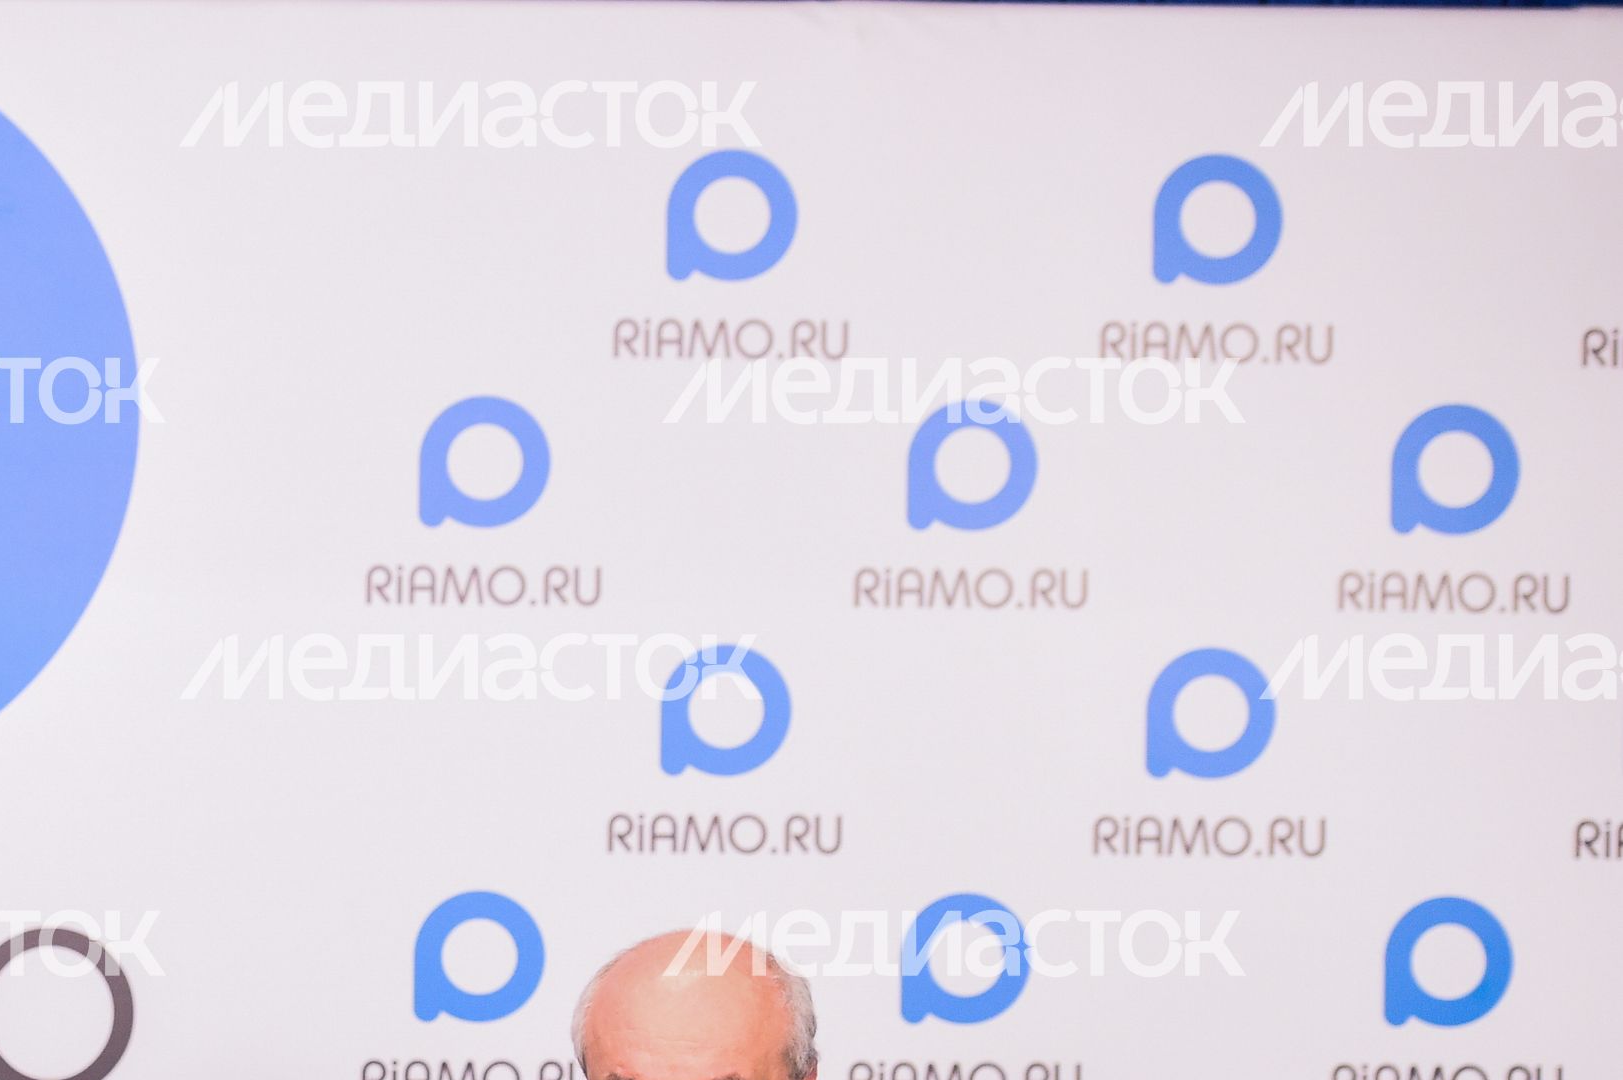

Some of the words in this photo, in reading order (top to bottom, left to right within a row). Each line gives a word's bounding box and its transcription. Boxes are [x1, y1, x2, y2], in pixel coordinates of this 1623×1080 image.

[613, 318, 850, 360] RiAMO.RU
[1099, 322, 1334, 364] RiAMO.RU
[365, 565, 602, 607] RiAMO.RU
[853, 567, 1089, 609] RiAMO.RU
[1338, 572, 1571, 615] RiAMO.RU
[607, 814, 843, 855] RiAMO.RU
[1093, 816, 1327, 858] RiAMO.RU
